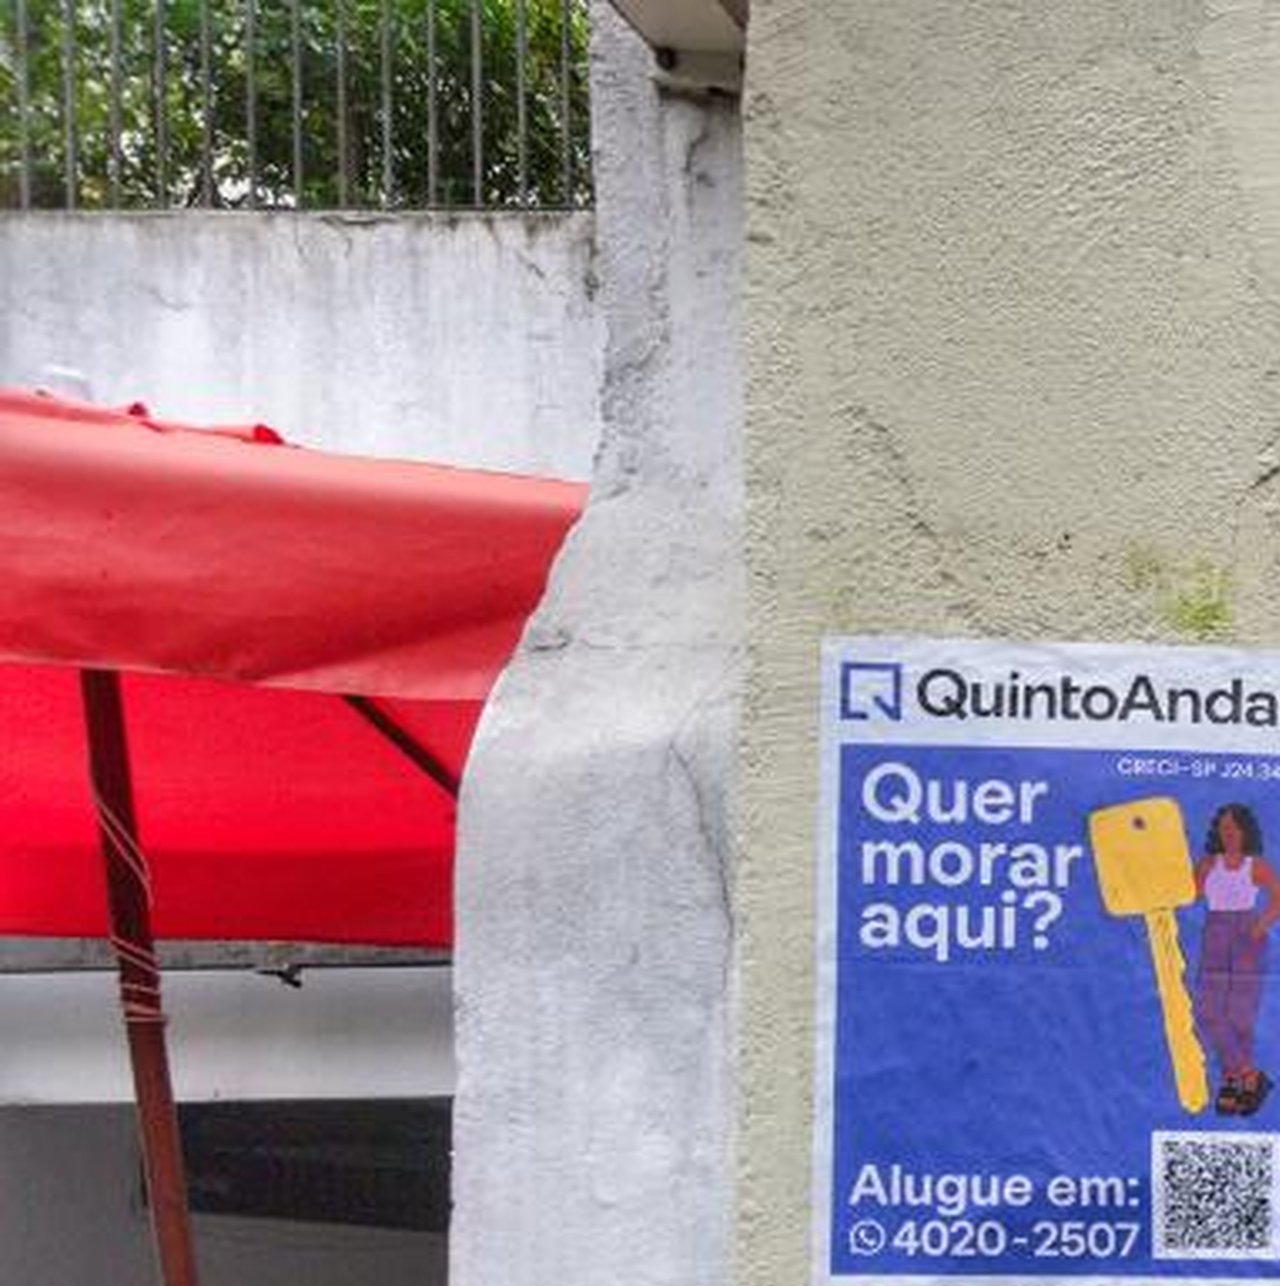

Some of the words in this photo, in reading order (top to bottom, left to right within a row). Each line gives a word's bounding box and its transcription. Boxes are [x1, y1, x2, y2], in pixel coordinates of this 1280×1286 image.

[862, 762, 1048, 824] Quer
[862, 841, 1083, 887] morar
[860, 890, 1062, 962] aqui?
[850, 1164, 1032, 1216] Alugue
[1047, 1174, 1139, 1206] em:
[893, 1220, 1140, 1257] 4020-2507
